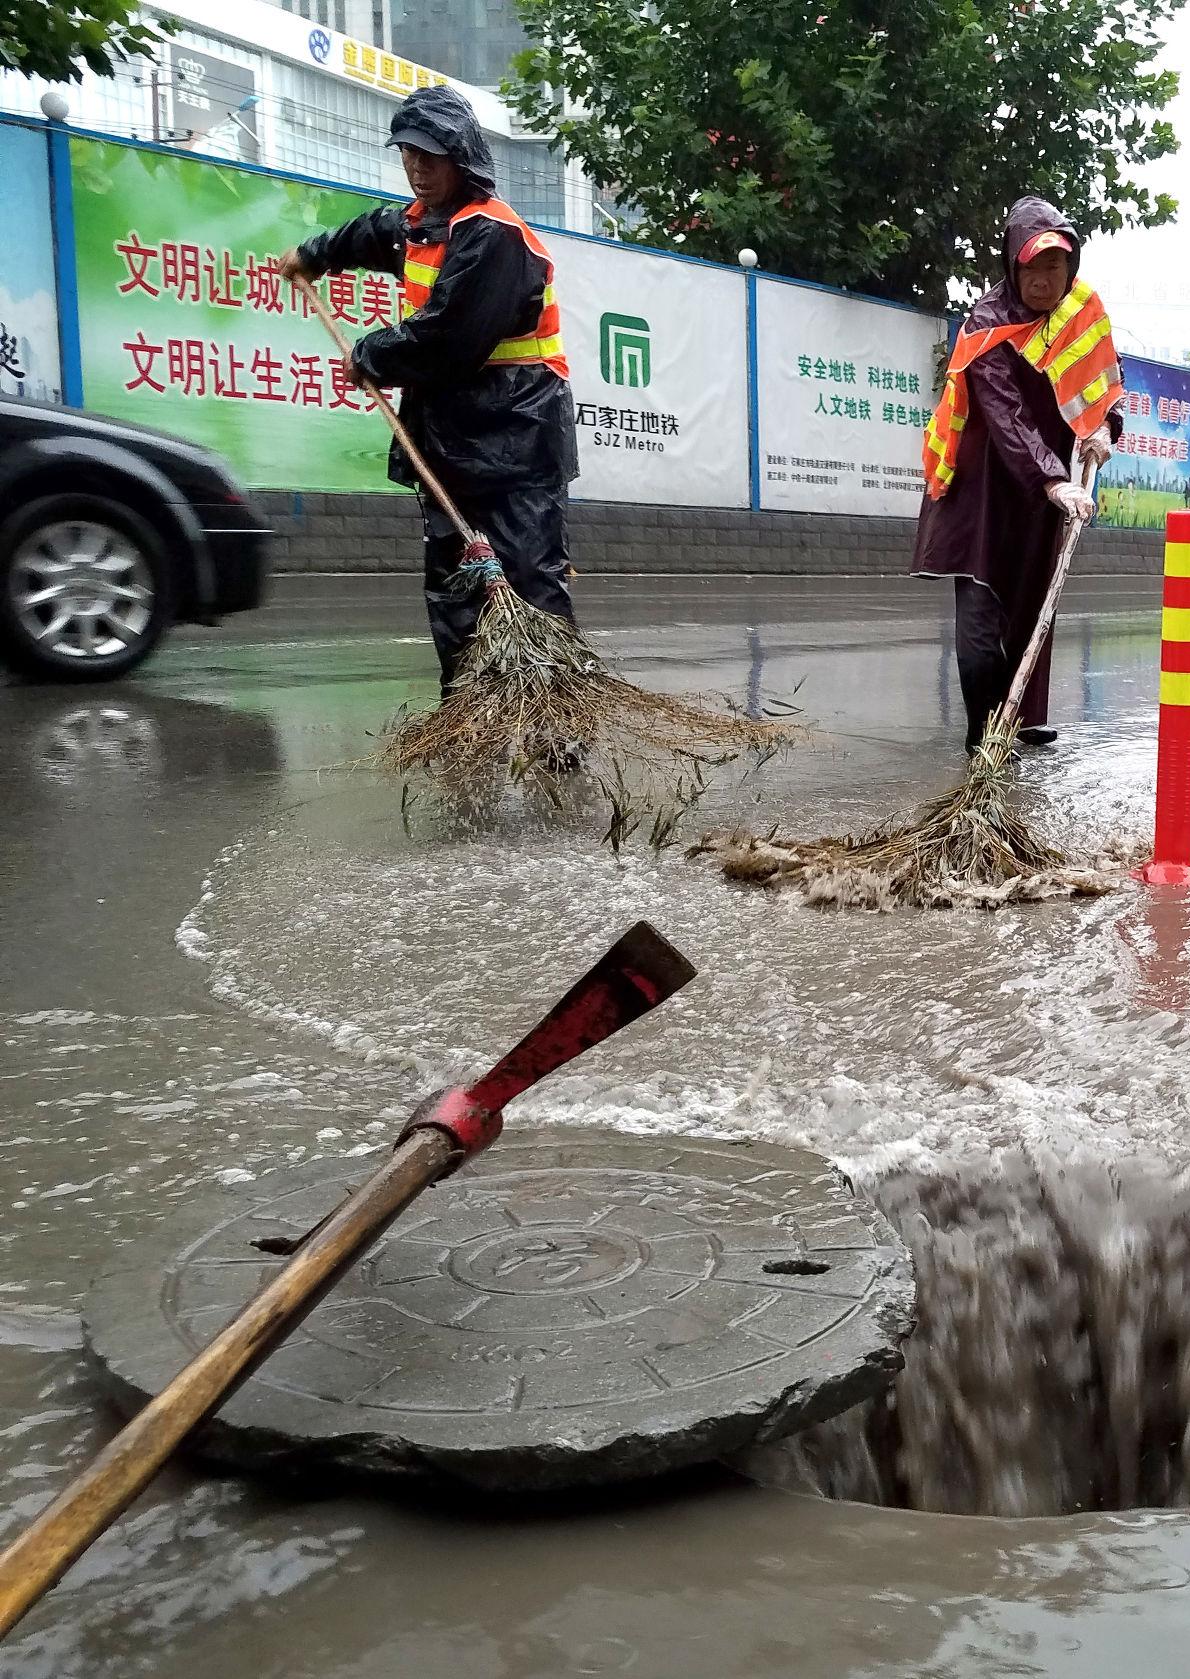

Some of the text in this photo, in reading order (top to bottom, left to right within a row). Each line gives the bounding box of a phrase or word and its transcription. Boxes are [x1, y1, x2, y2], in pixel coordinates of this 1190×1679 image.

[798, 354, 920, 395] 安全地铁 科技地铁
[575, 403, 680, 436] 石家庄地铁
[814, 393, 933, 428] 人文地铁 绿色地铁
[594, 432, 664, 453] SJZ Metro
[1117, 432, 1189, 461] 建设幸福石家庄
